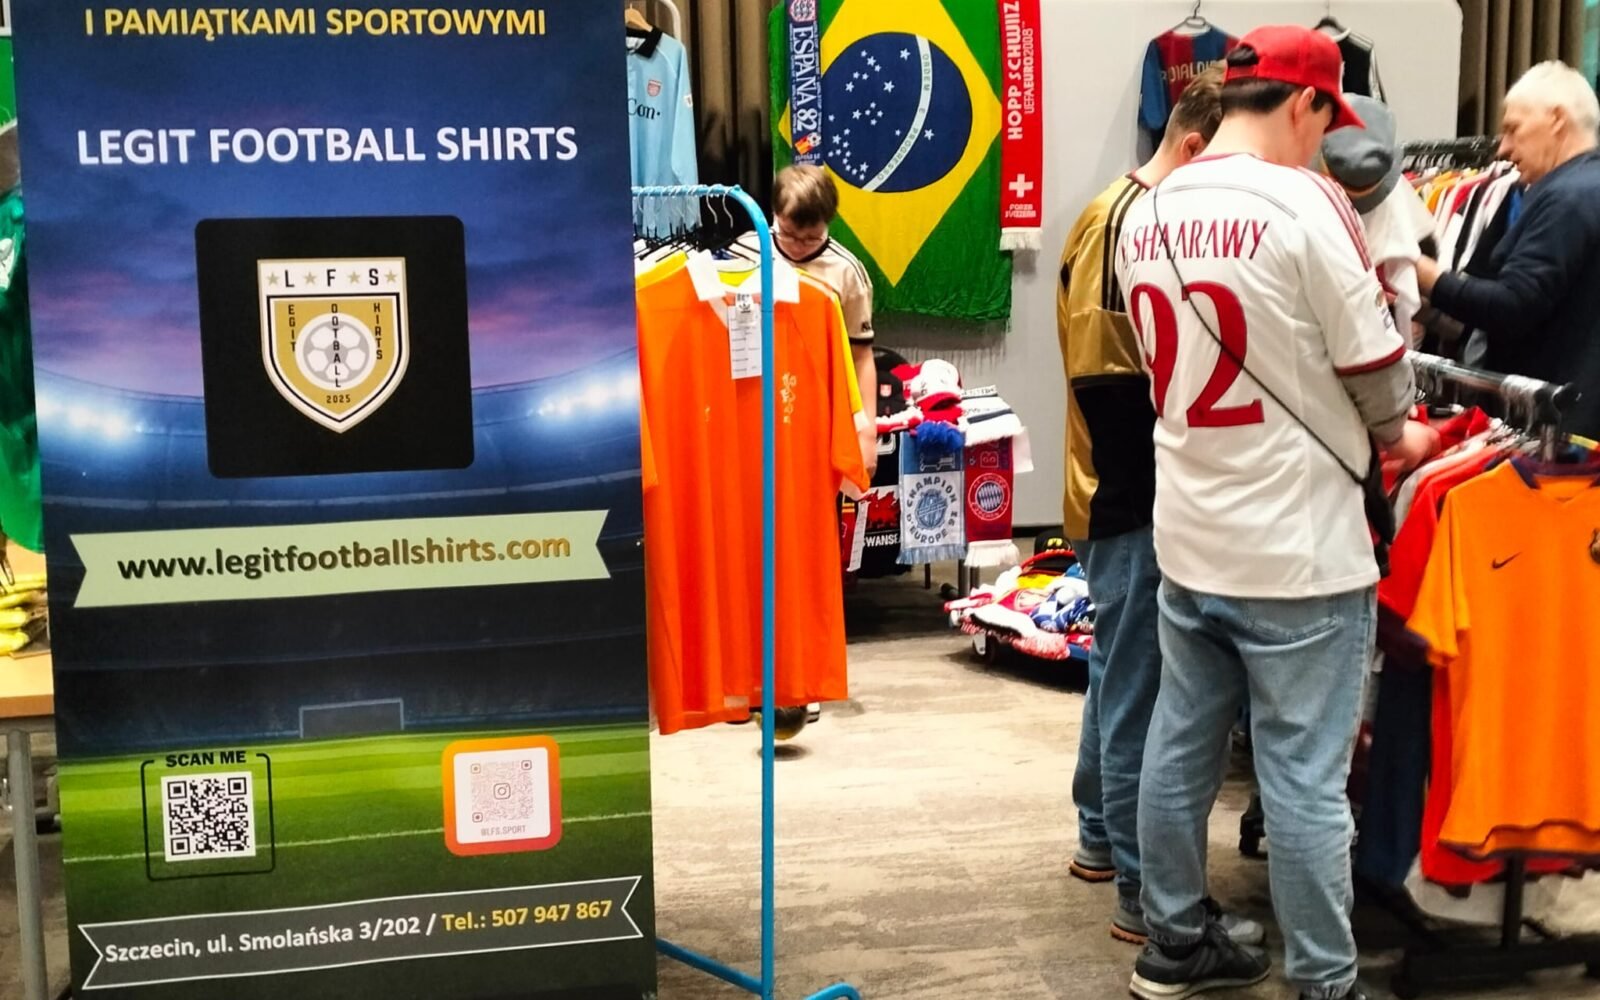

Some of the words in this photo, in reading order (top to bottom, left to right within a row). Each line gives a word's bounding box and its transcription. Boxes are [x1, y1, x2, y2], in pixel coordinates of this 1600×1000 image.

[85, 9, 93, 35] I
[104, 8, 316, 41] PAMIĄTKAMI
[326, 8, 546, 35] SPORTOWYMI
[921, 53, 931, 92] ORDEM
[797, 108, 818, 131] 82
[1007, 85, 1023, 140] HOPP
[78, 129, 196, 165] LEGIT
[210, 127, 426, 163] FOOTBALL
[436, 126, 578, 161] SHIRTS
[1133, 218, 1269, 263] SHAARAWY
[284, 270, 295, 288] L
[327, 269, 337, 287] F
[369, 268, 379, 286] S
[288, 304, 296, 353] EGIT
[331, 303, 341, 388] OOTBALL
[374, 302, 383, 360] HIRTS
[1130, 280, 1265, 428] 92
[326, 394, 351, 404] 2025
[117, 537, 571, 580] www.legitfootballshirts.com
[864, 534, 900, 548] WANSE
[166, 752, 214, 768] SCAN
[220, 750, 247, 764] ME
[105, 938, 201, 963] Szczecin,
[207, 934, 233, 954] ul.
[239, 925, 353, 951] Smolańska
[359, 917, 421, 941] 3/202
[425, 913, 437, 937] /
[441, 911, 487, 931] Tel.:
[492, 908, 529, 927] 507
[534, 904, 571, 924] 947
[576, 900, 613, 920] 867
